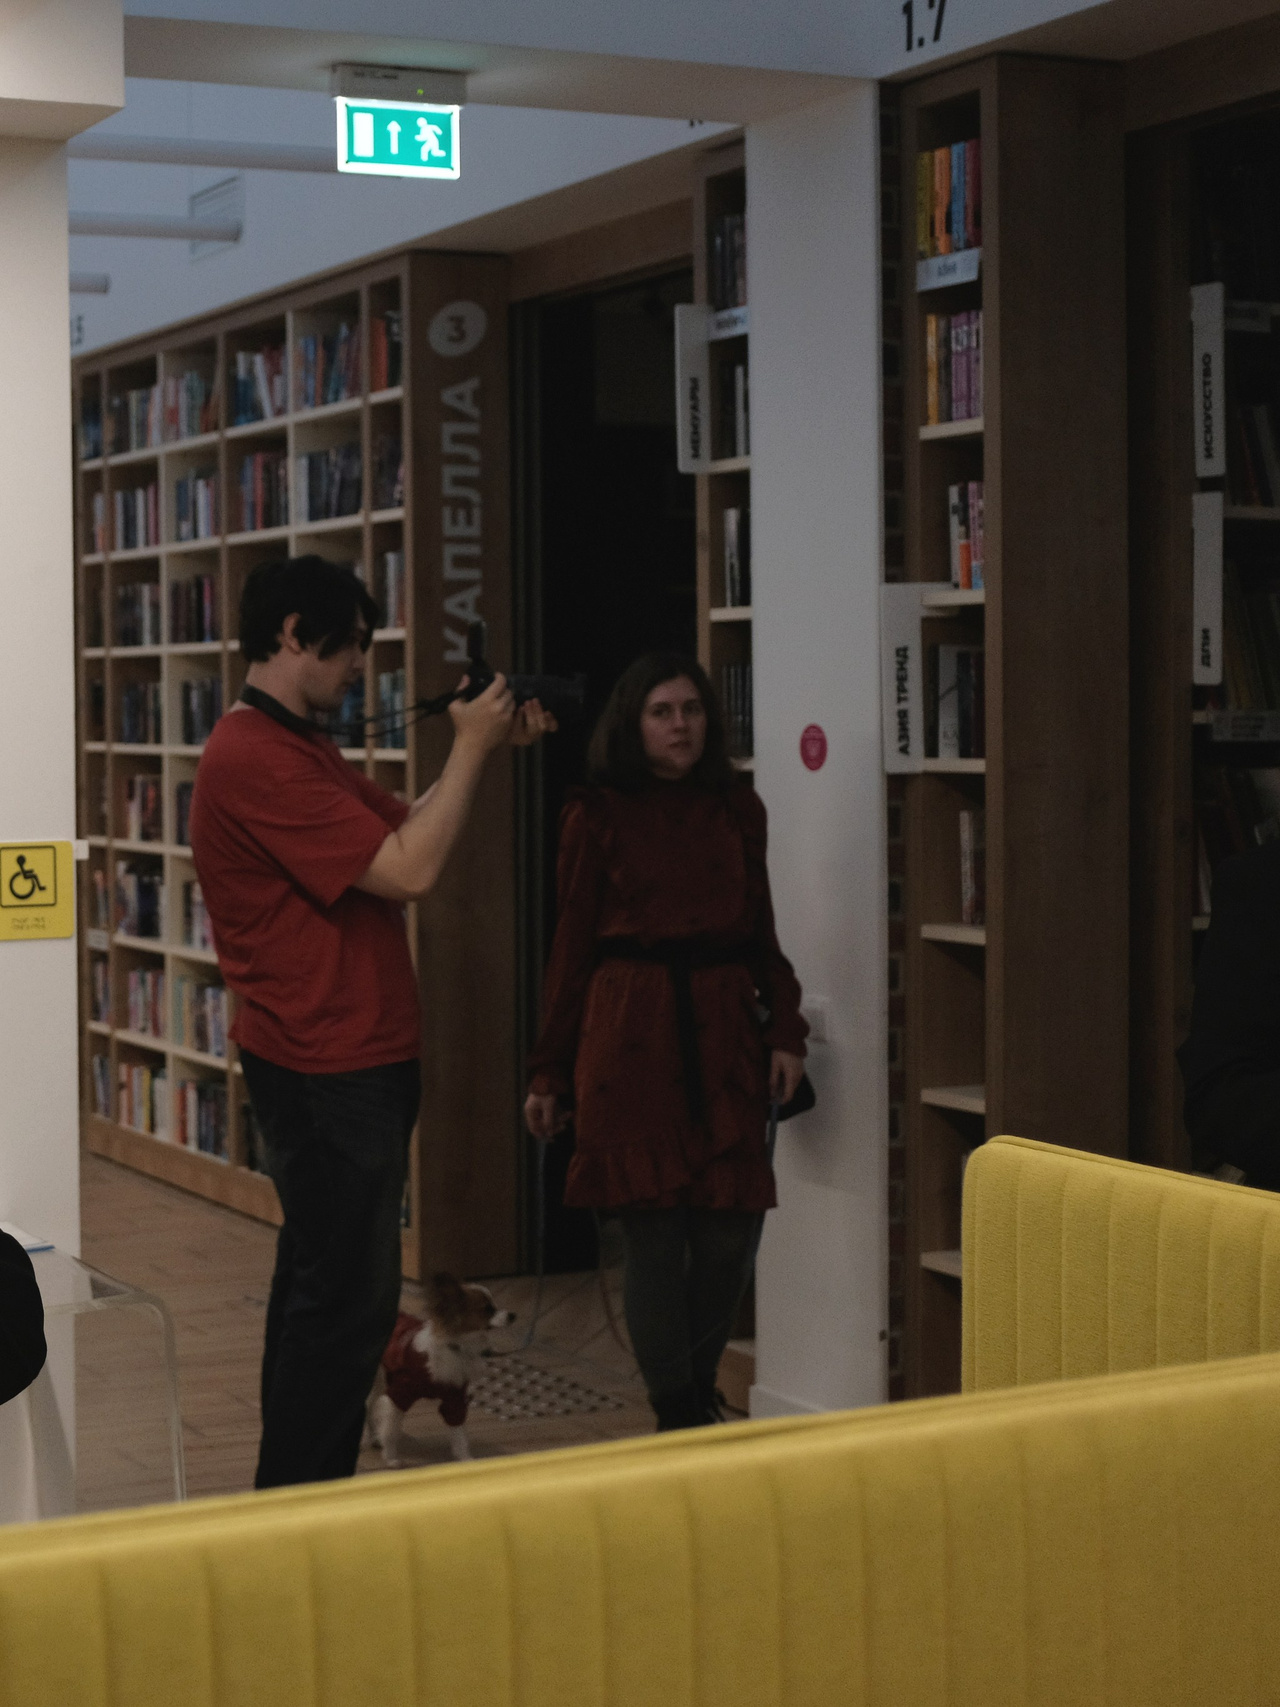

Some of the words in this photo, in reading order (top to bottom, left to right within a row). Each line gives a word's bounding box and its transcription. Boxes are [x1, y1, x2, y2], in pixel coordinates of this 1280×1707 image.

[903, 0, 946, 51] 1.7
[447, 315, 466, 342] 3
[689, 376, 701, 460] МЕМУАРЫ
[1202, 352, 1213, 460] ИСКУССТВО
[441, 376, 483, 662] КАПЕЛЛА
[895, 645, 909, 704] ТРЕНД
[897, 708, 910, 756] АЗИЯ
